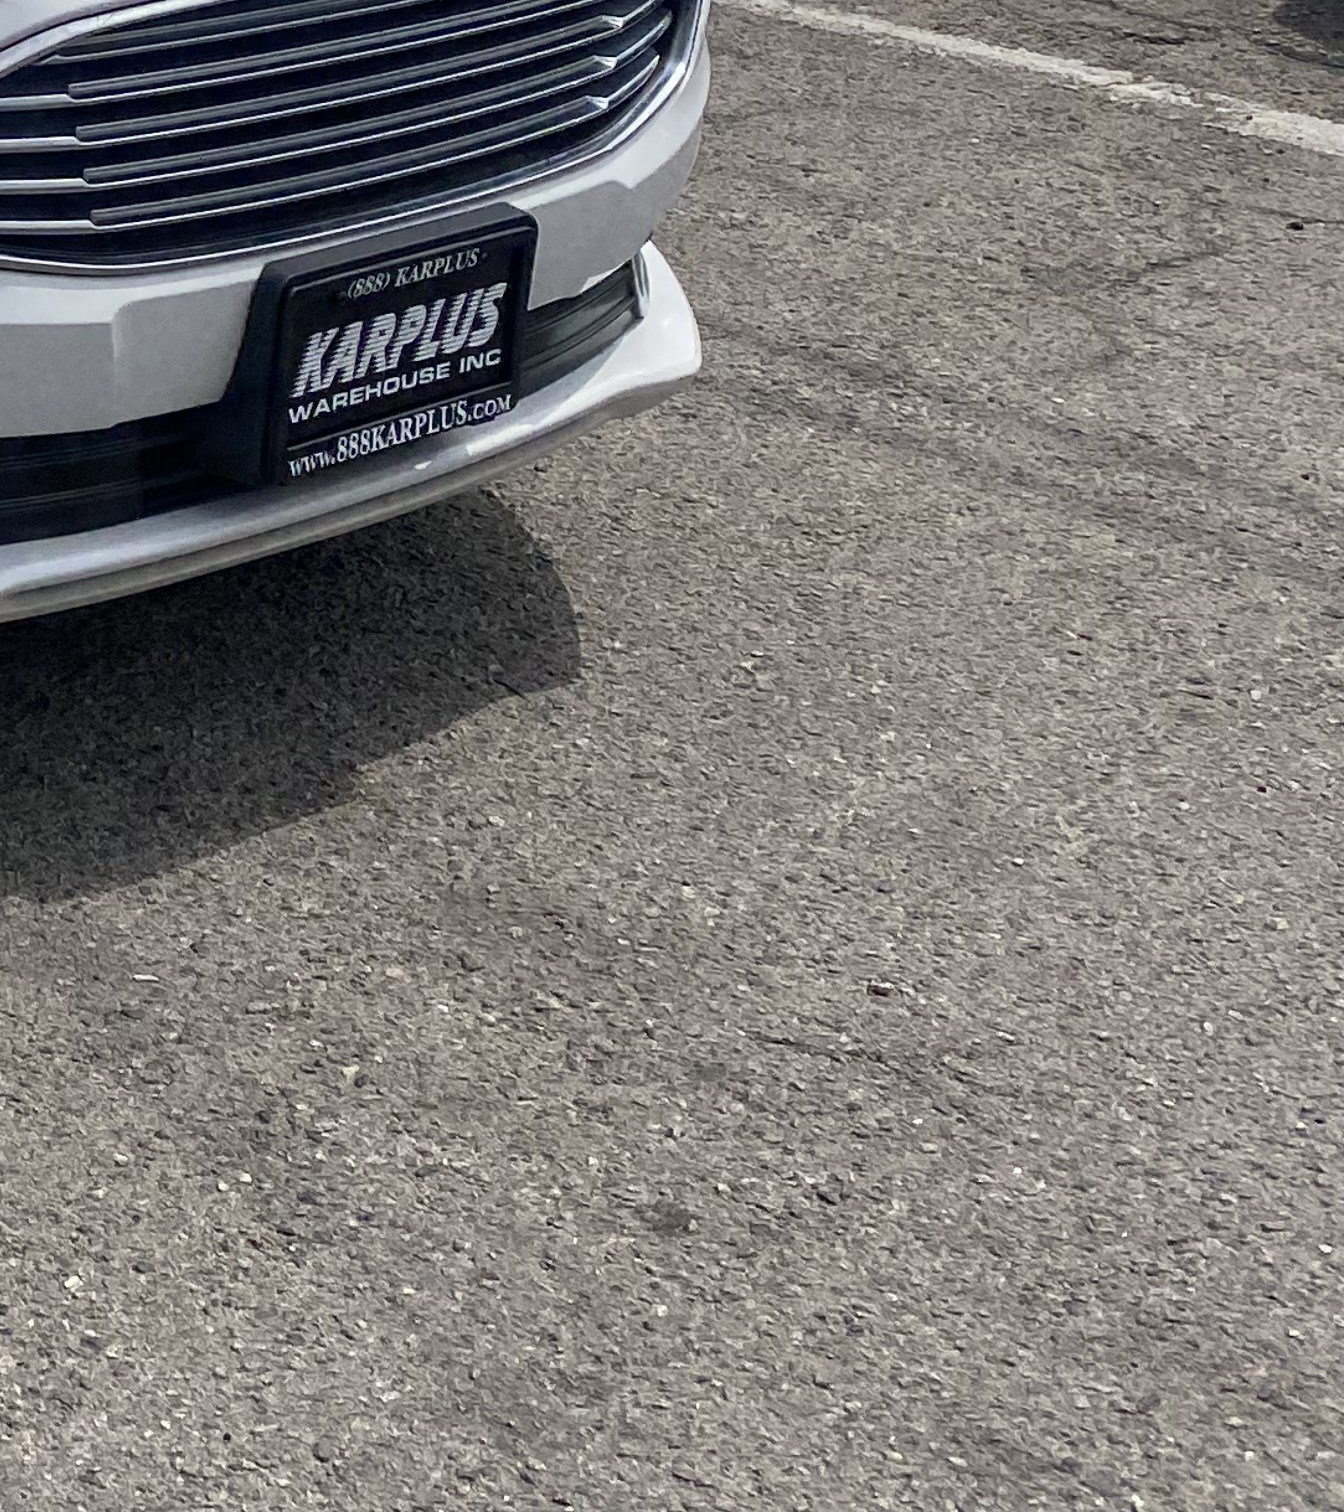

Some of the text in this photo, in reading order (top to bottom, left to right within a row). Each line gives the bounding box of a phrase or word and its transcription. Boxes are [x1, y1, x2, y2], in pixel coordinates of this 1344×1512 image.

[347, 247, 481, 300] (888) KARPLUS
[288, 282, 508, 399] KARPLUS
[287, 348, 502, 424] WAREHOUSE INC
